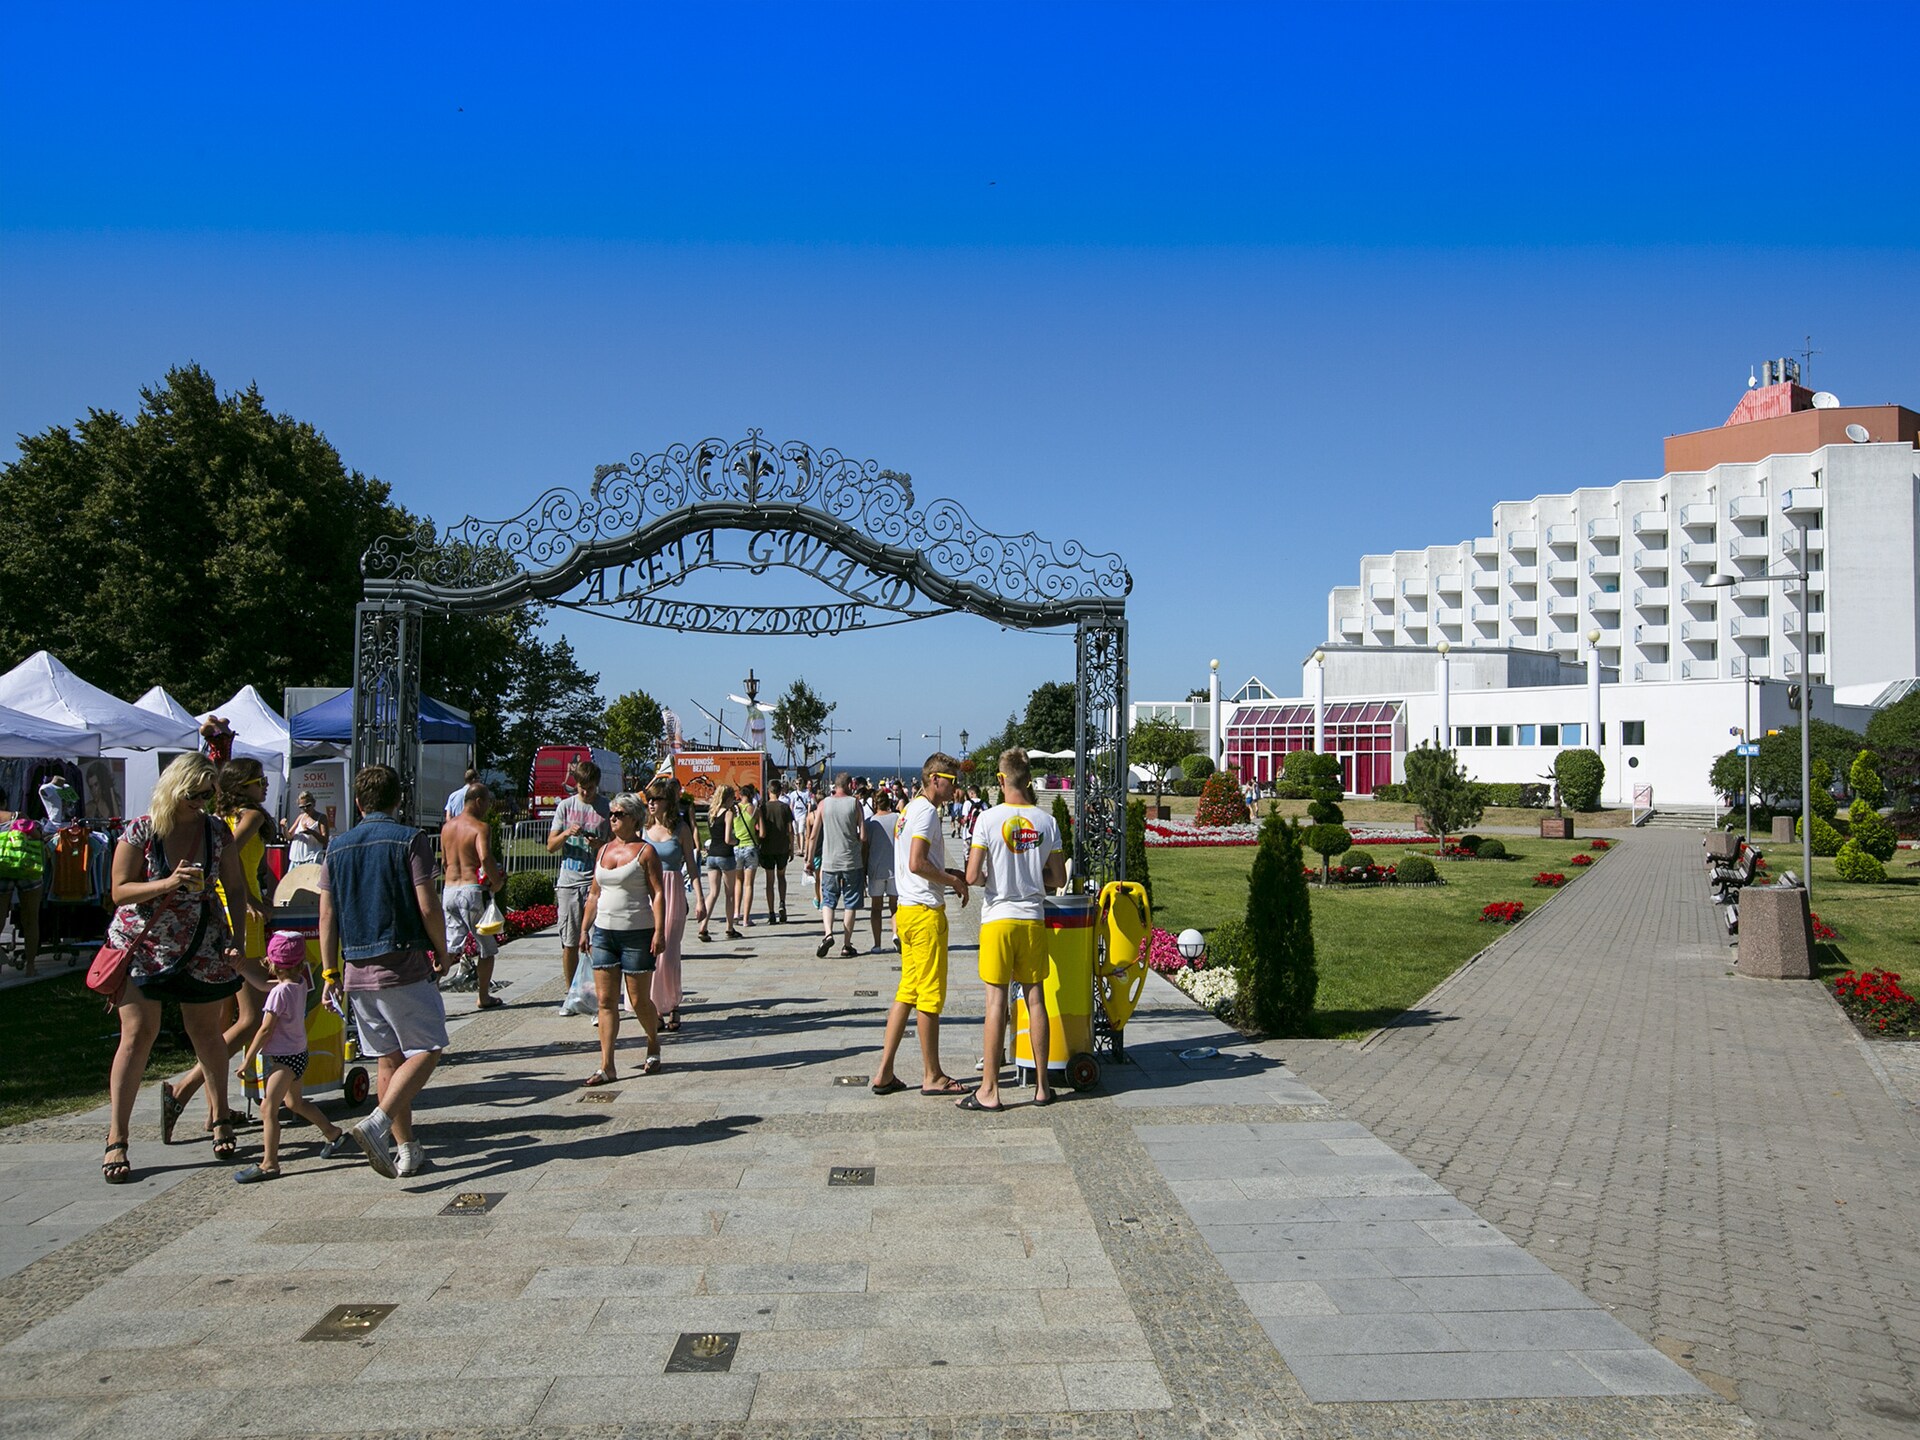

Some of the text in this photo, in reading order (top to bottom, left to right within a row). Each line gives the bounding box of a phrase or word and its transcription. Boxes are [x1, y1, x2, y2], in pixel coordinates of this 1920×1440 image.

[579, 528, 916, 609] ALEJA GWIAZD
[303, 772, 327, 781] SOKI
[1013, 831, 1037, 840] Lipton
